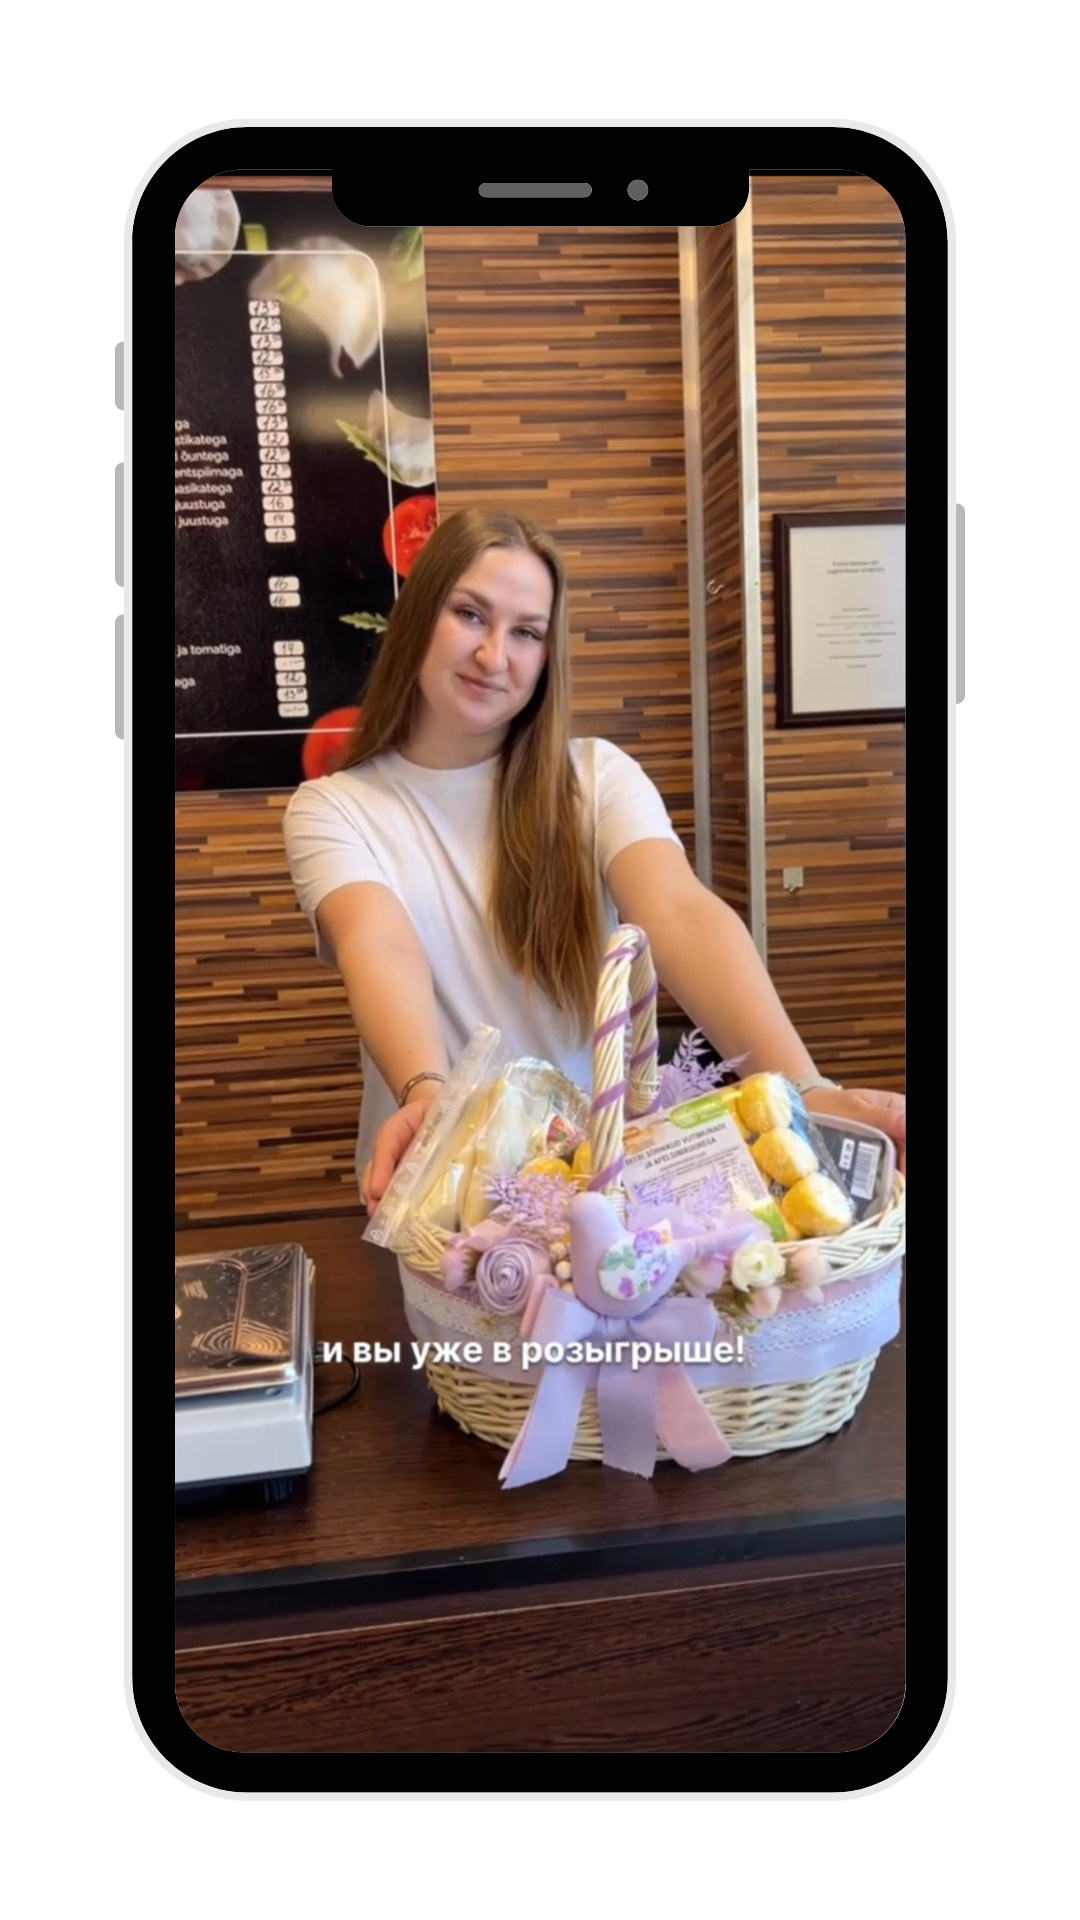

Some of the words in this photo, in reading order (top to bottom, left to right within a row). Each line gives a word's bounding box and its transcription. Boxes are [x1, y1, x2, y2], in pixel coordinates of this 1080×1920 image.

[181, 450, 229, 463] õuntega
[178, 515, 229, 528] juustuga
[190, 644, 242, 657] tomatiga
